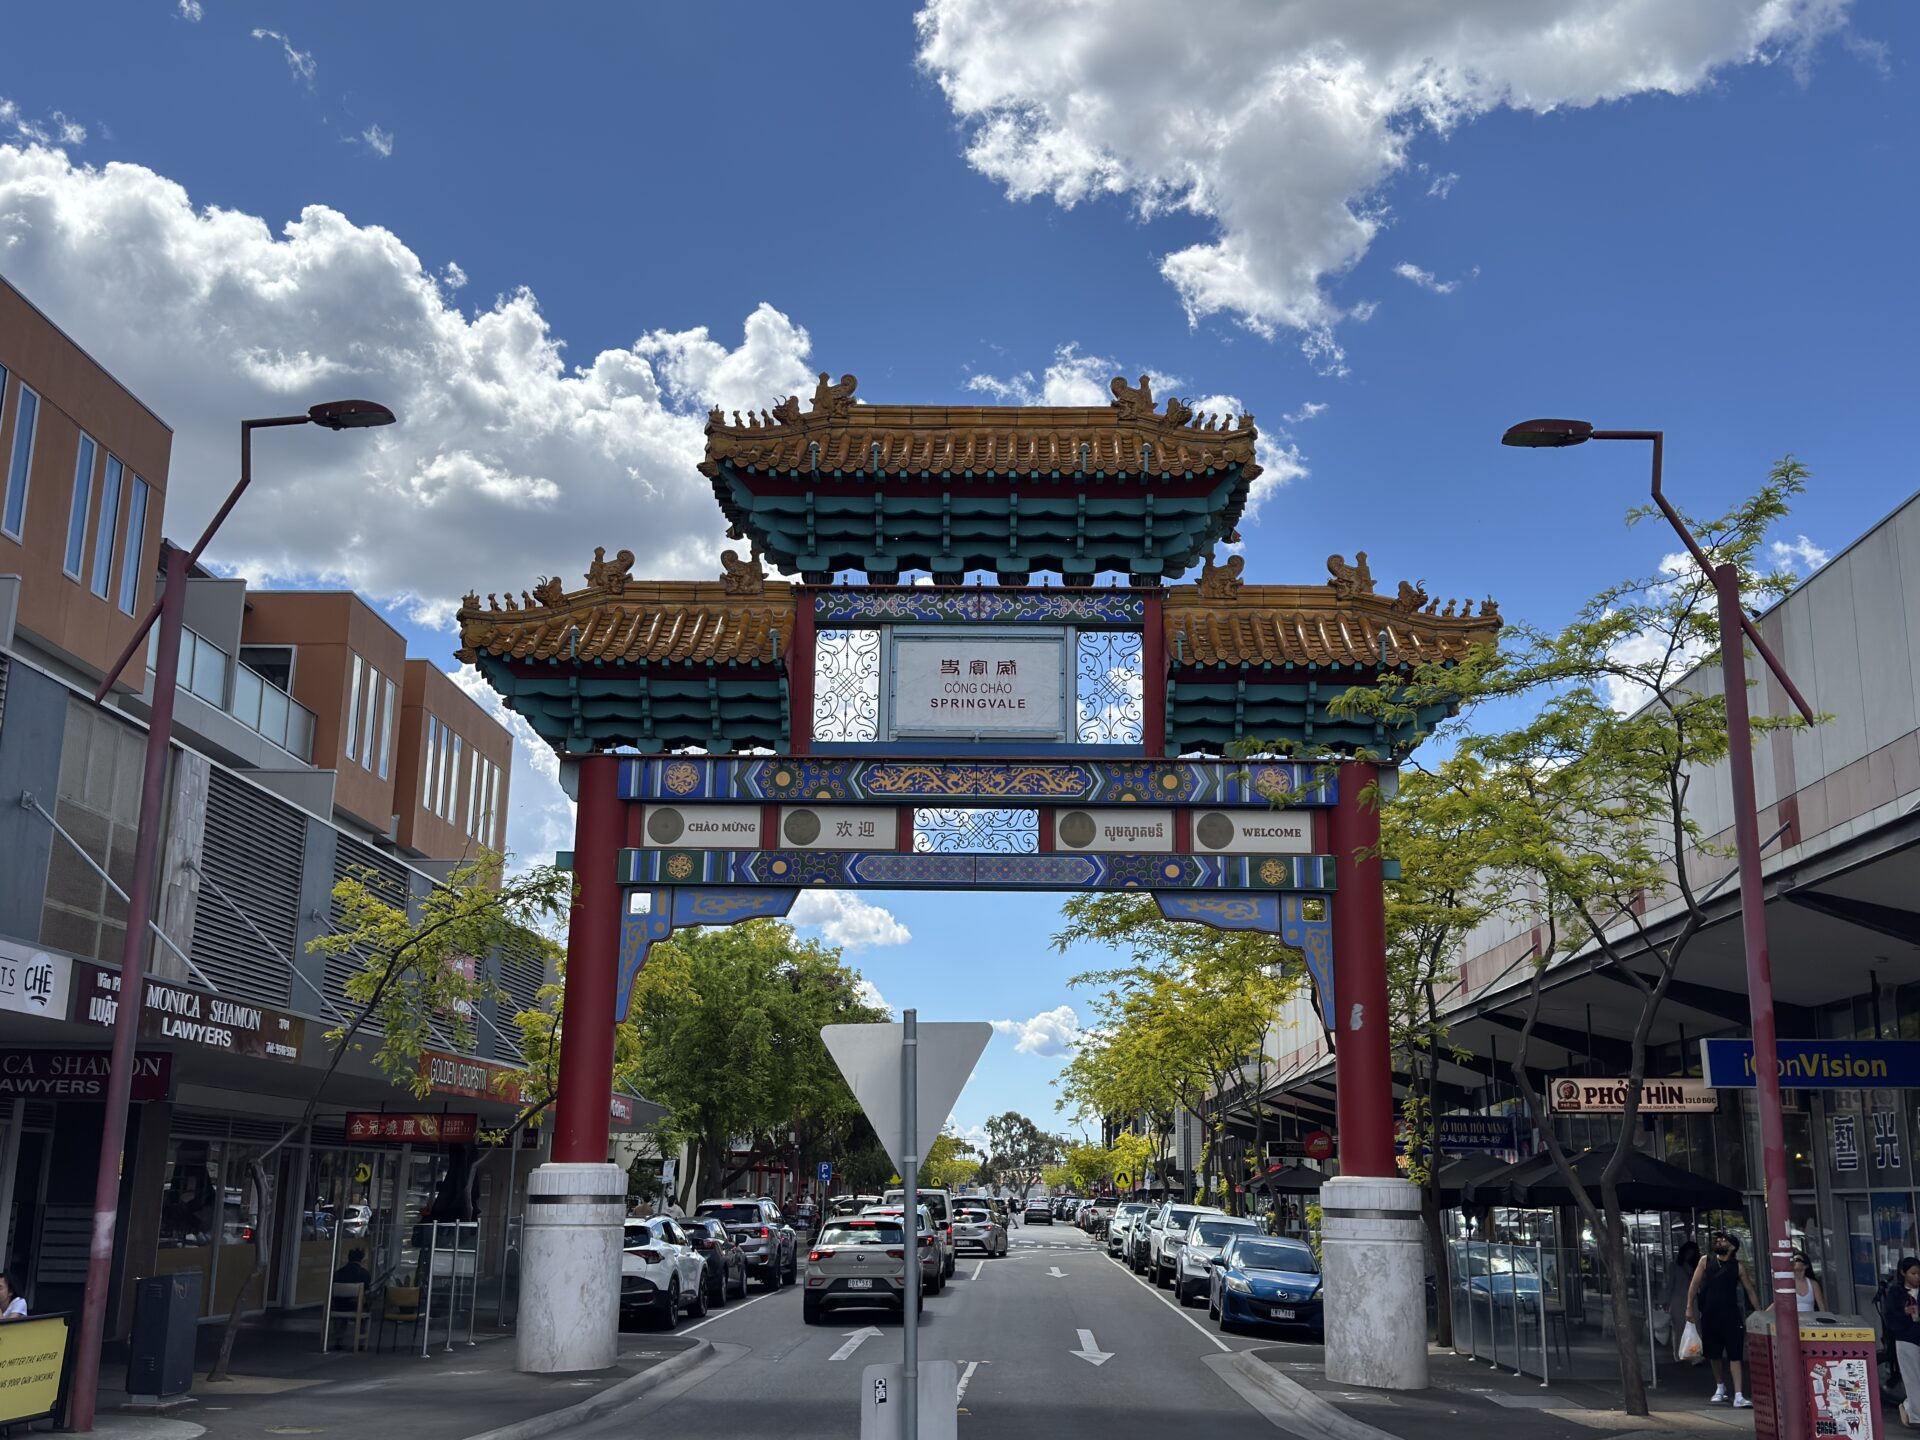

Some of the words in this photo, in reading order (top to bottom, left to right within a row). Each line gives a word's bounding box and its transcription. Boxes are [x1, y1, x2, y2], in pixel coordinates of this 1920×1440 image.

[930, 698, 1026, 709] SPRINGVALE
[688, 821, 719, 832] CHÀO
[836, 821, 875, 837] 欢迎
[1243, 827, 1302, 838] WELCOME
[145, 984, 200, 1019] MONICA
[209, 999, 262, 1032] SHAMON
[162, 1017, 232, 1048] LAWYERS
[431, 1057, 457, 1085] GOLDEN
[1641, 1081, 1684, 1105] HÌN
[821, 1164, 829, 1173] P
[1856, 1361, 1870, 1408] Springvale
